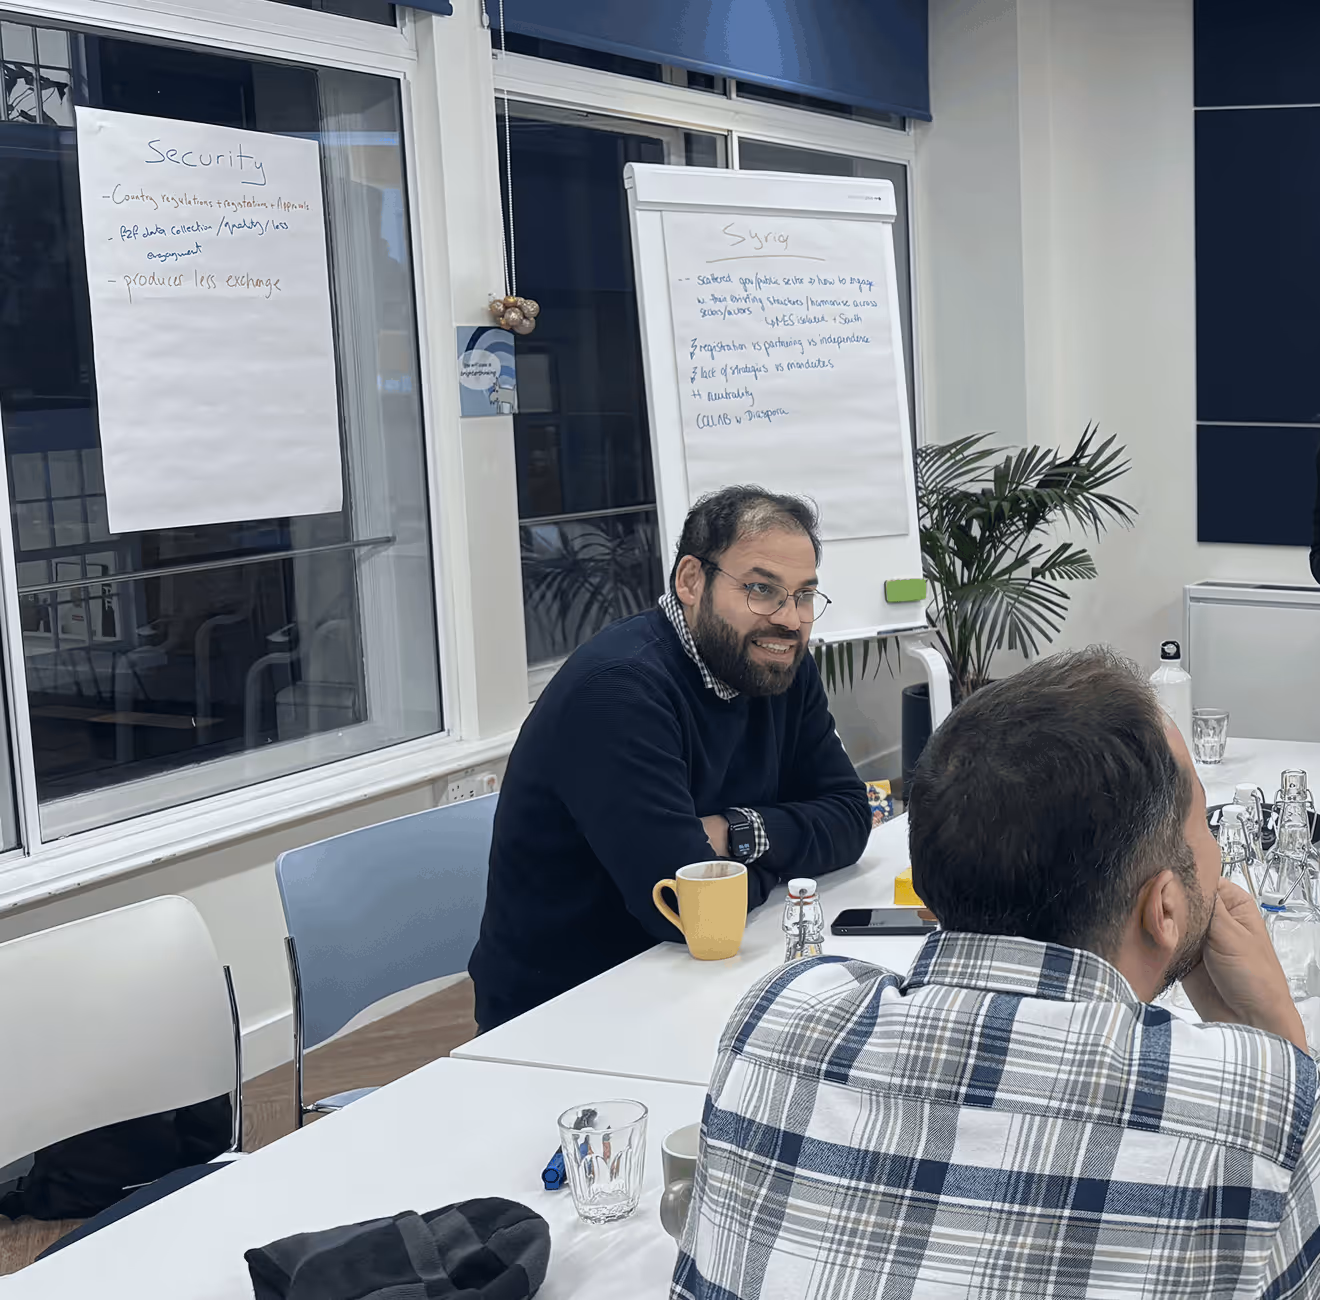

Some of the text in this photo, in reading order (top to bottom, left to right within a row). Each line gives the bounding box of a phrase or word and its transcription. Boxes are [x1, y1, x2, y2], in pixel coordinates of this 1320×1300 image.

[145, 139, 267, 186] Security
[112, 183, 159, 211] Country
[142, 223, 167, 238] data
[722, 222, 790, 251] Syria
[193, 269, 217, 290] less
[225, 271, 282, 300] exchange
[815, 274, 836, 286] how
[837, 275, 847, 286] to
[700, 365, 717, 379] lack
[720, 362, 729, 383] of
[706, 385, 755, 408] neutrality
[743, 407, 790, 423] Diaspora
